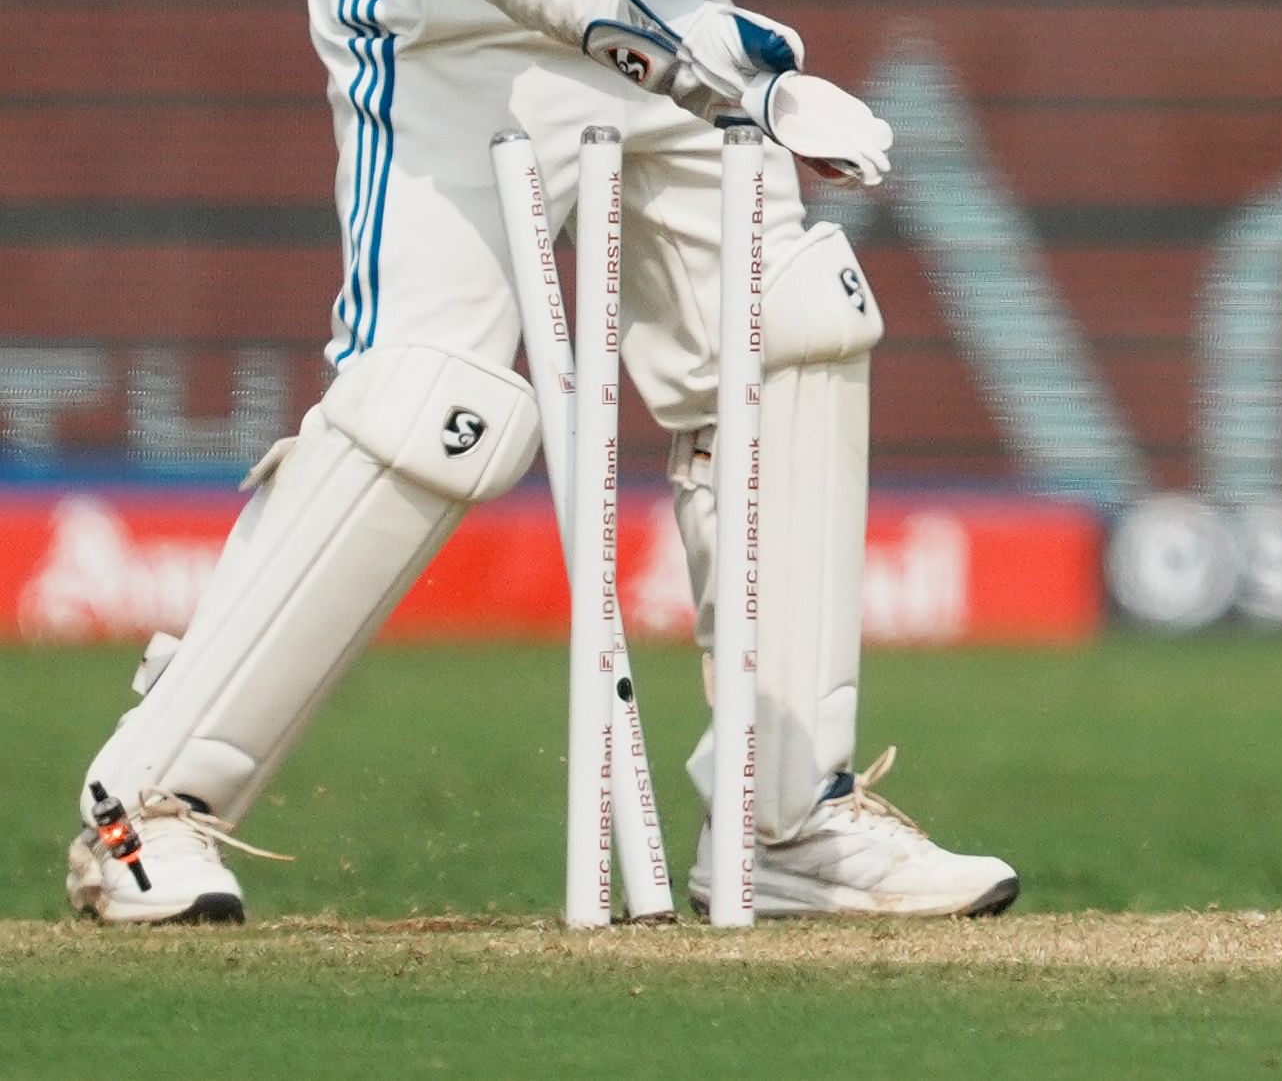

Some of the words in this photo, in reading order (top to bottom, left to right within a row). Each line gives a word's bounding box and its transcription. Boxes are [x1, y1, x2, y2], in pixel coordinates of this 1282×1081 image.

[526, 166, 546, 217] Bank
[608, 170, 621, 224] Bank
[752, 170, 764, 224] Bank
[536, 226, 557, 286] FIRST
[607, 233, 620, 294] FIRST
[751, 233, 763, 294] FIRST
[548, 293, 568, 343] IDFC
[606, 302, 618, 353] IDFC
[750, 302, 762, 353] IDFC
[604, 437, 617, 490] Bank
[748, 437, 760, 490] Bank
[602, 498, 616, 561] FIRST
[747, 498, 759, 561] FIRST
[602, 569, 615, 620] IDFC
[746, 569, 758, 620] IDFC
[602, 725, 613, 778] Bank
[625, 702, 645, 756] Bank
[744, 725, 757, 777] Bank
[600, 789, 612, 851] FIRST
[635, 766, 660, 827] FIRST
[743, 786, 755, 850] FIRST
[600, 860, 611, 910] IDFC
[647, 837, 668, 887] IDFC
[742, 860, 754, 910] IDFC
